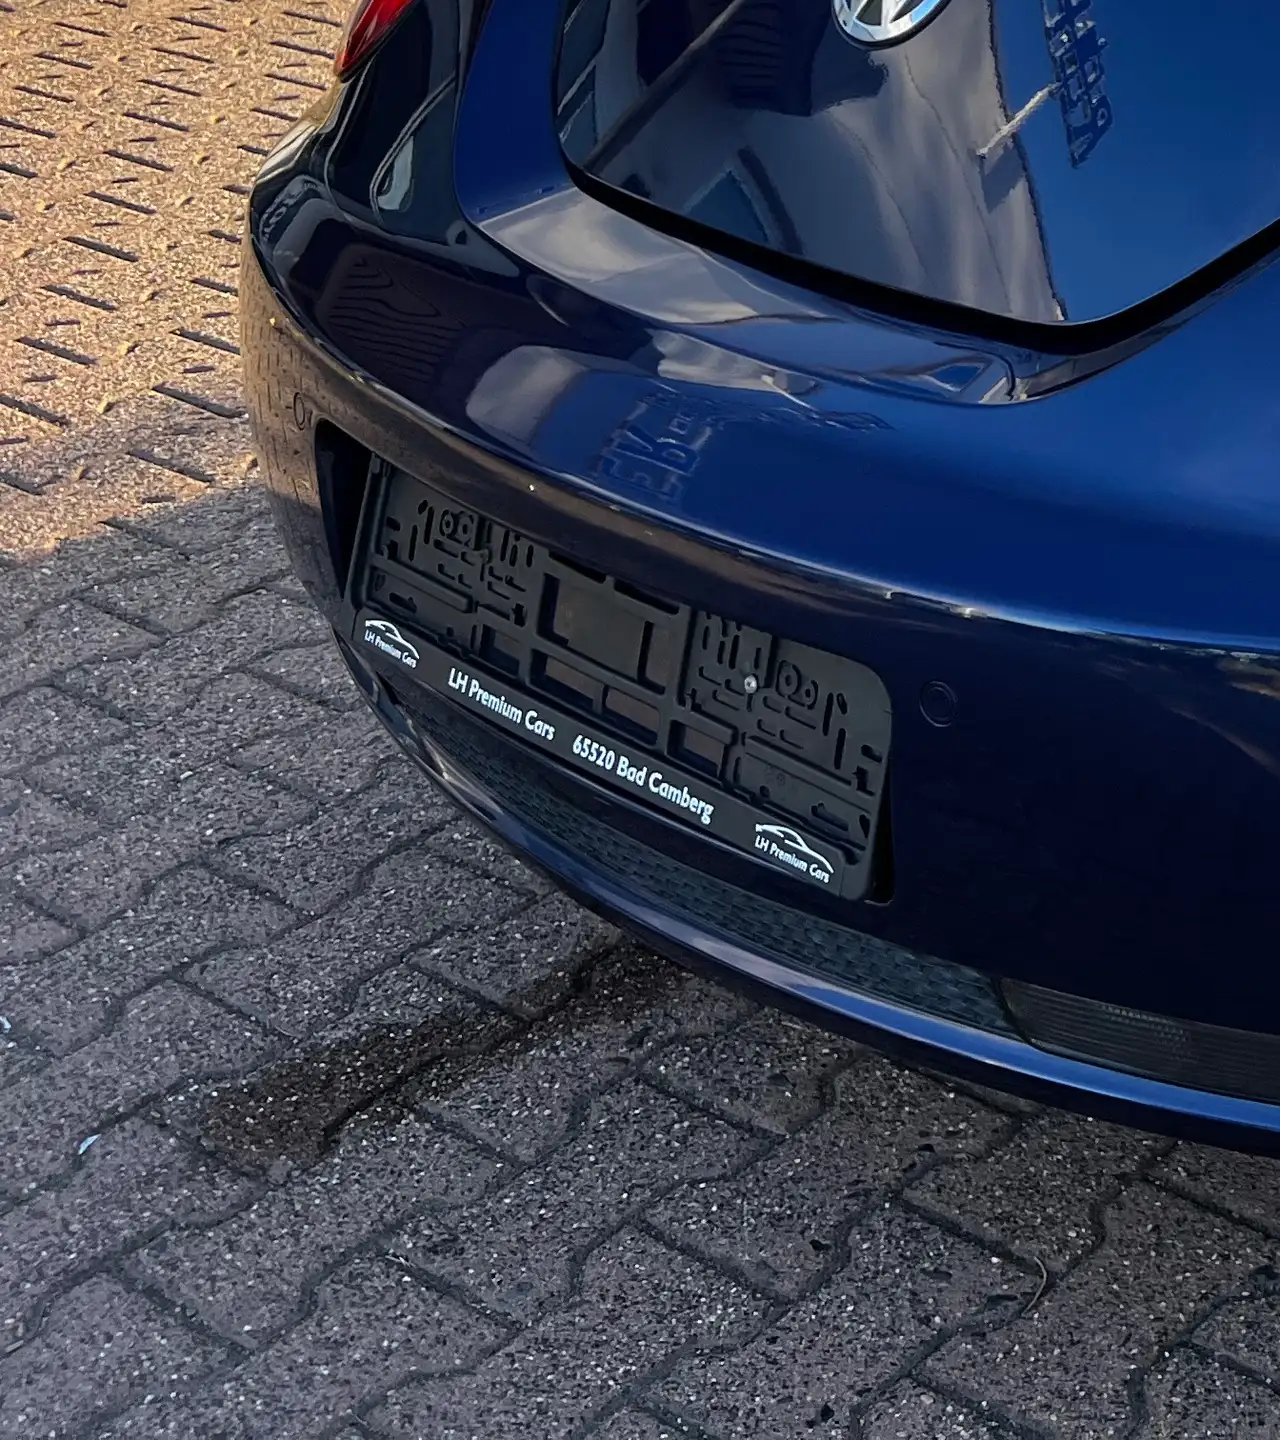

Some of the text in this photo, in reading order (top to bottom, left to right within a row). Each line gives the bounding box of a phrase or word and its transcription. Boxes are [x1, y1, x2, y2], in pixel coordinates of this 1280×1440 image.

[447, 667, 715, 825] LH Premium Cars 65520 Bad Camberg
[754, 835, 830, 884] LH Premium Cars
